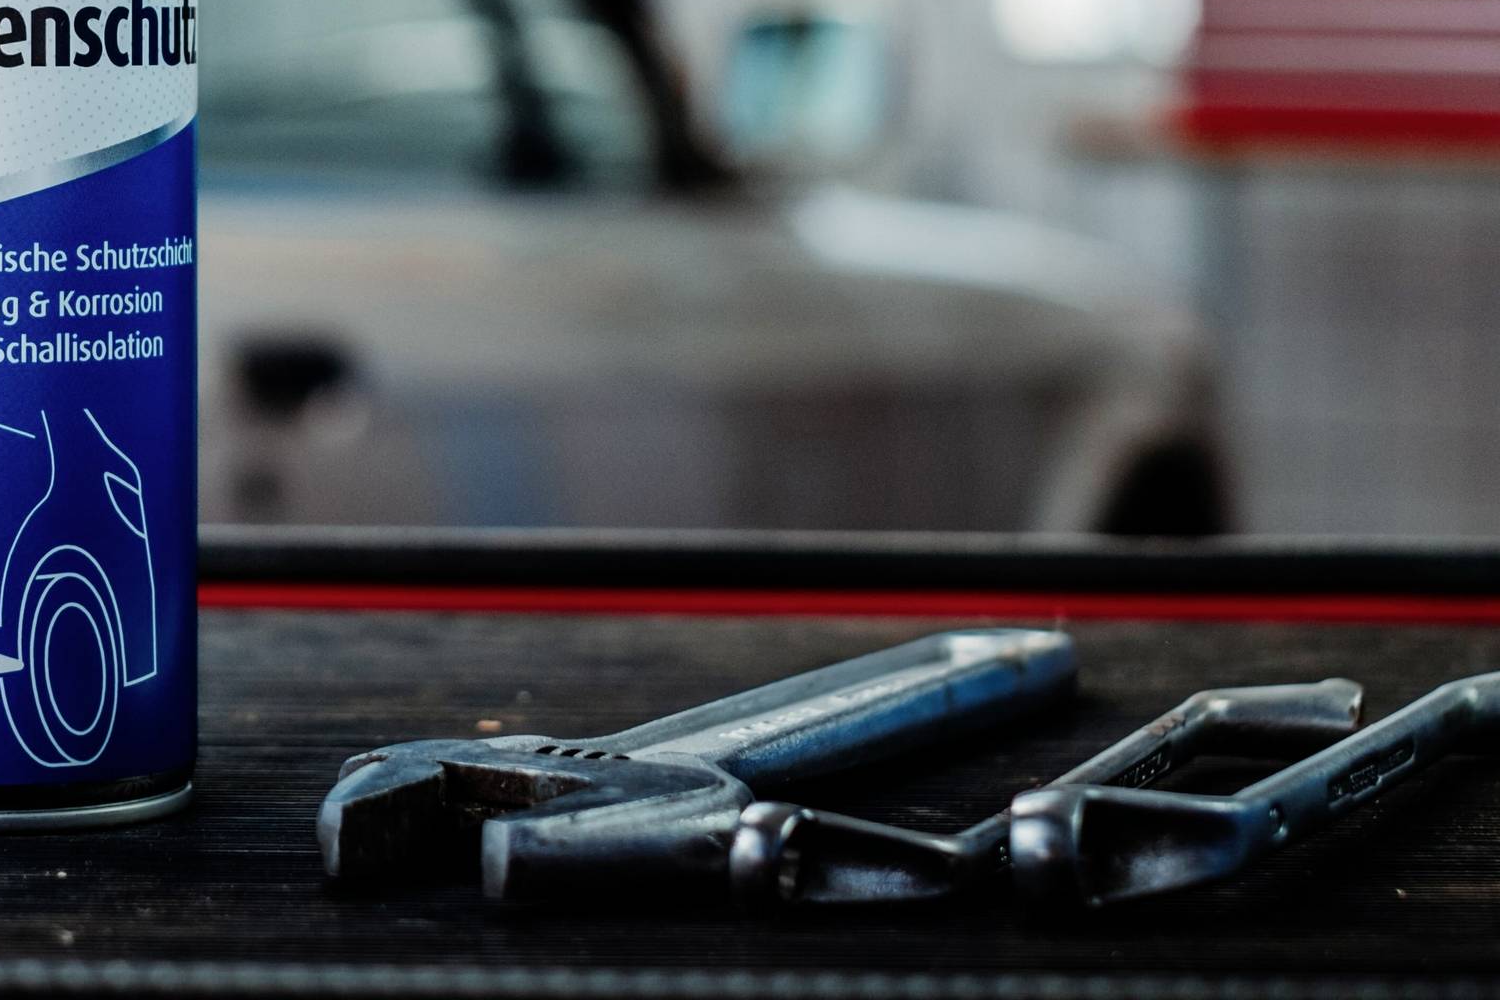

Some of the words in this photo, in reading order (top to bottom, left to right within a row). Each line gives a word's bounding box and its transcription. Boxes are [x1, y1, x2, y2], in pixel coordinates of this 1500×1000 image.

[76, 235, 193, 272] Schutzschicht
[28, 290, 50, 318] &
[58, 285, 163, 318] Korrosion
